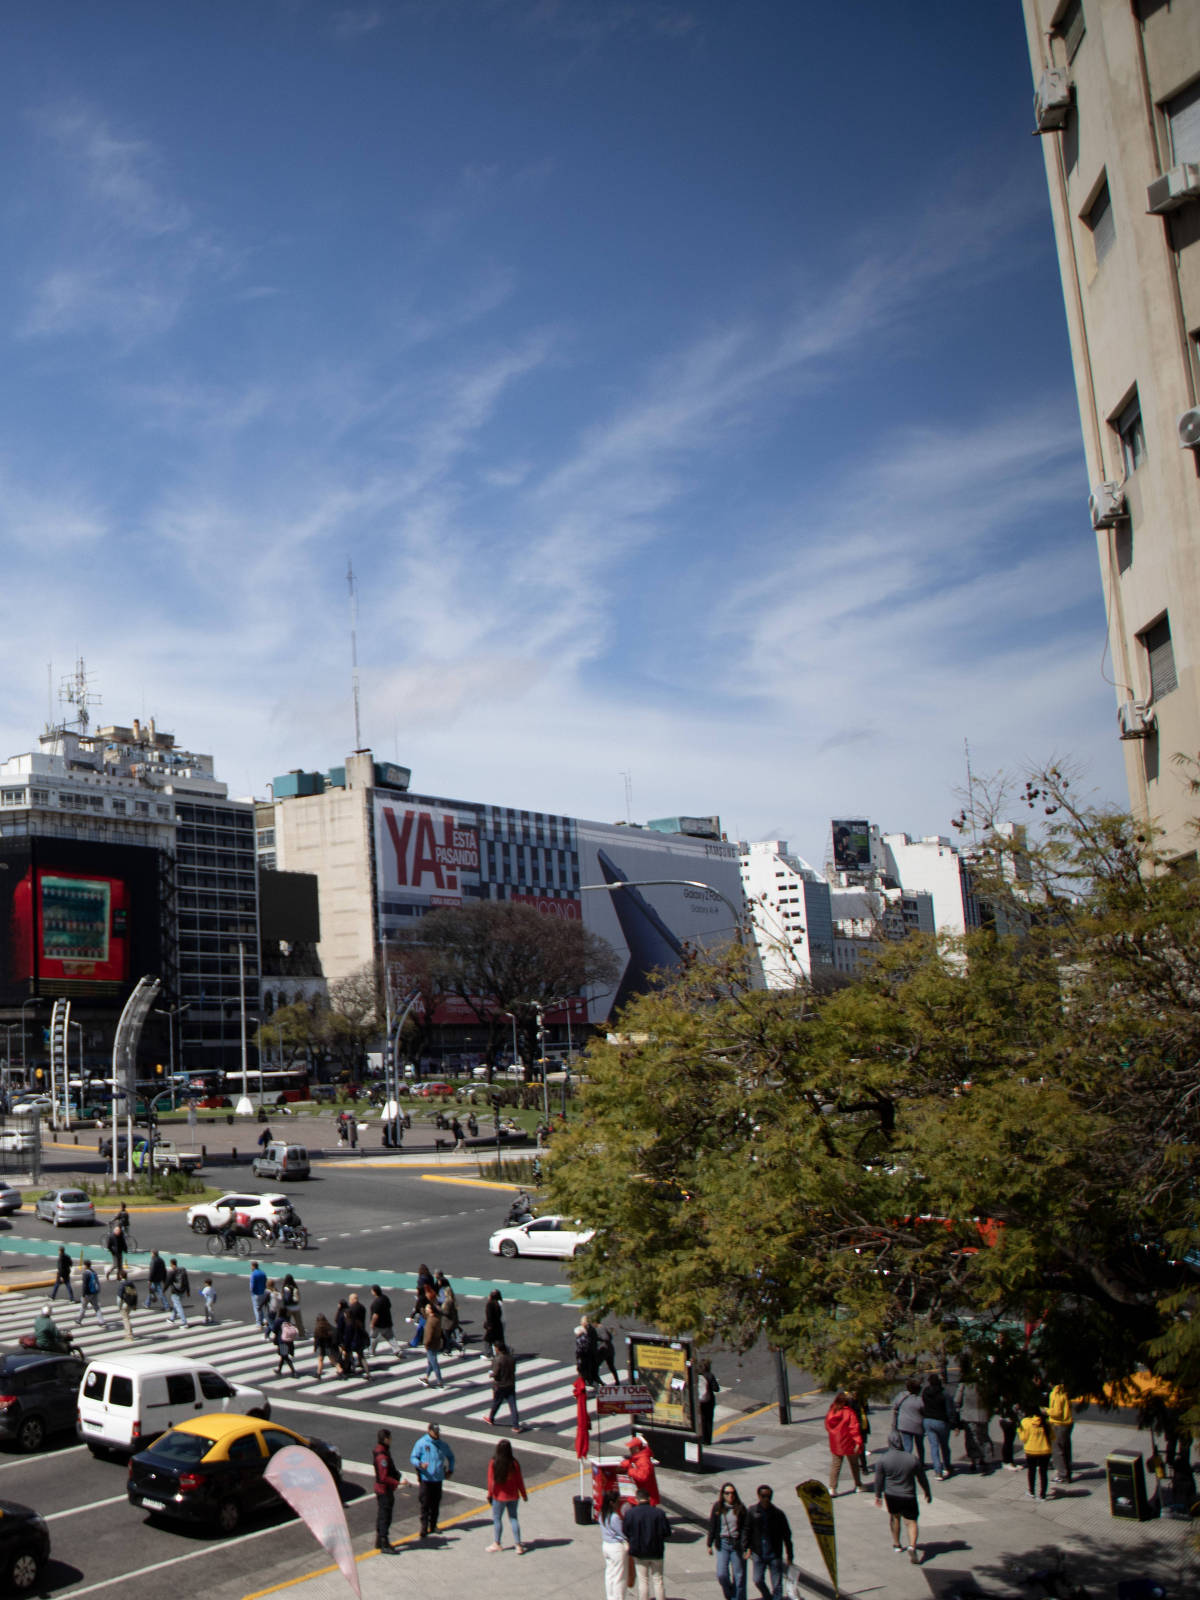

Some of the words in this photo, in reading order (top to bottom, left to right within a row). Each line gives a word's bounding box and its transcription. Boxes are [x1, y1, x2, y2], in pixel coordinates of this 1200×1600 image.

[435, 847, 479, 868] PASANDO
[704, 843, 736, 858] SAMSUNG
[599, 1386, 618, 1395] CITY
[622, 1386, 649, 1395] TOUR
